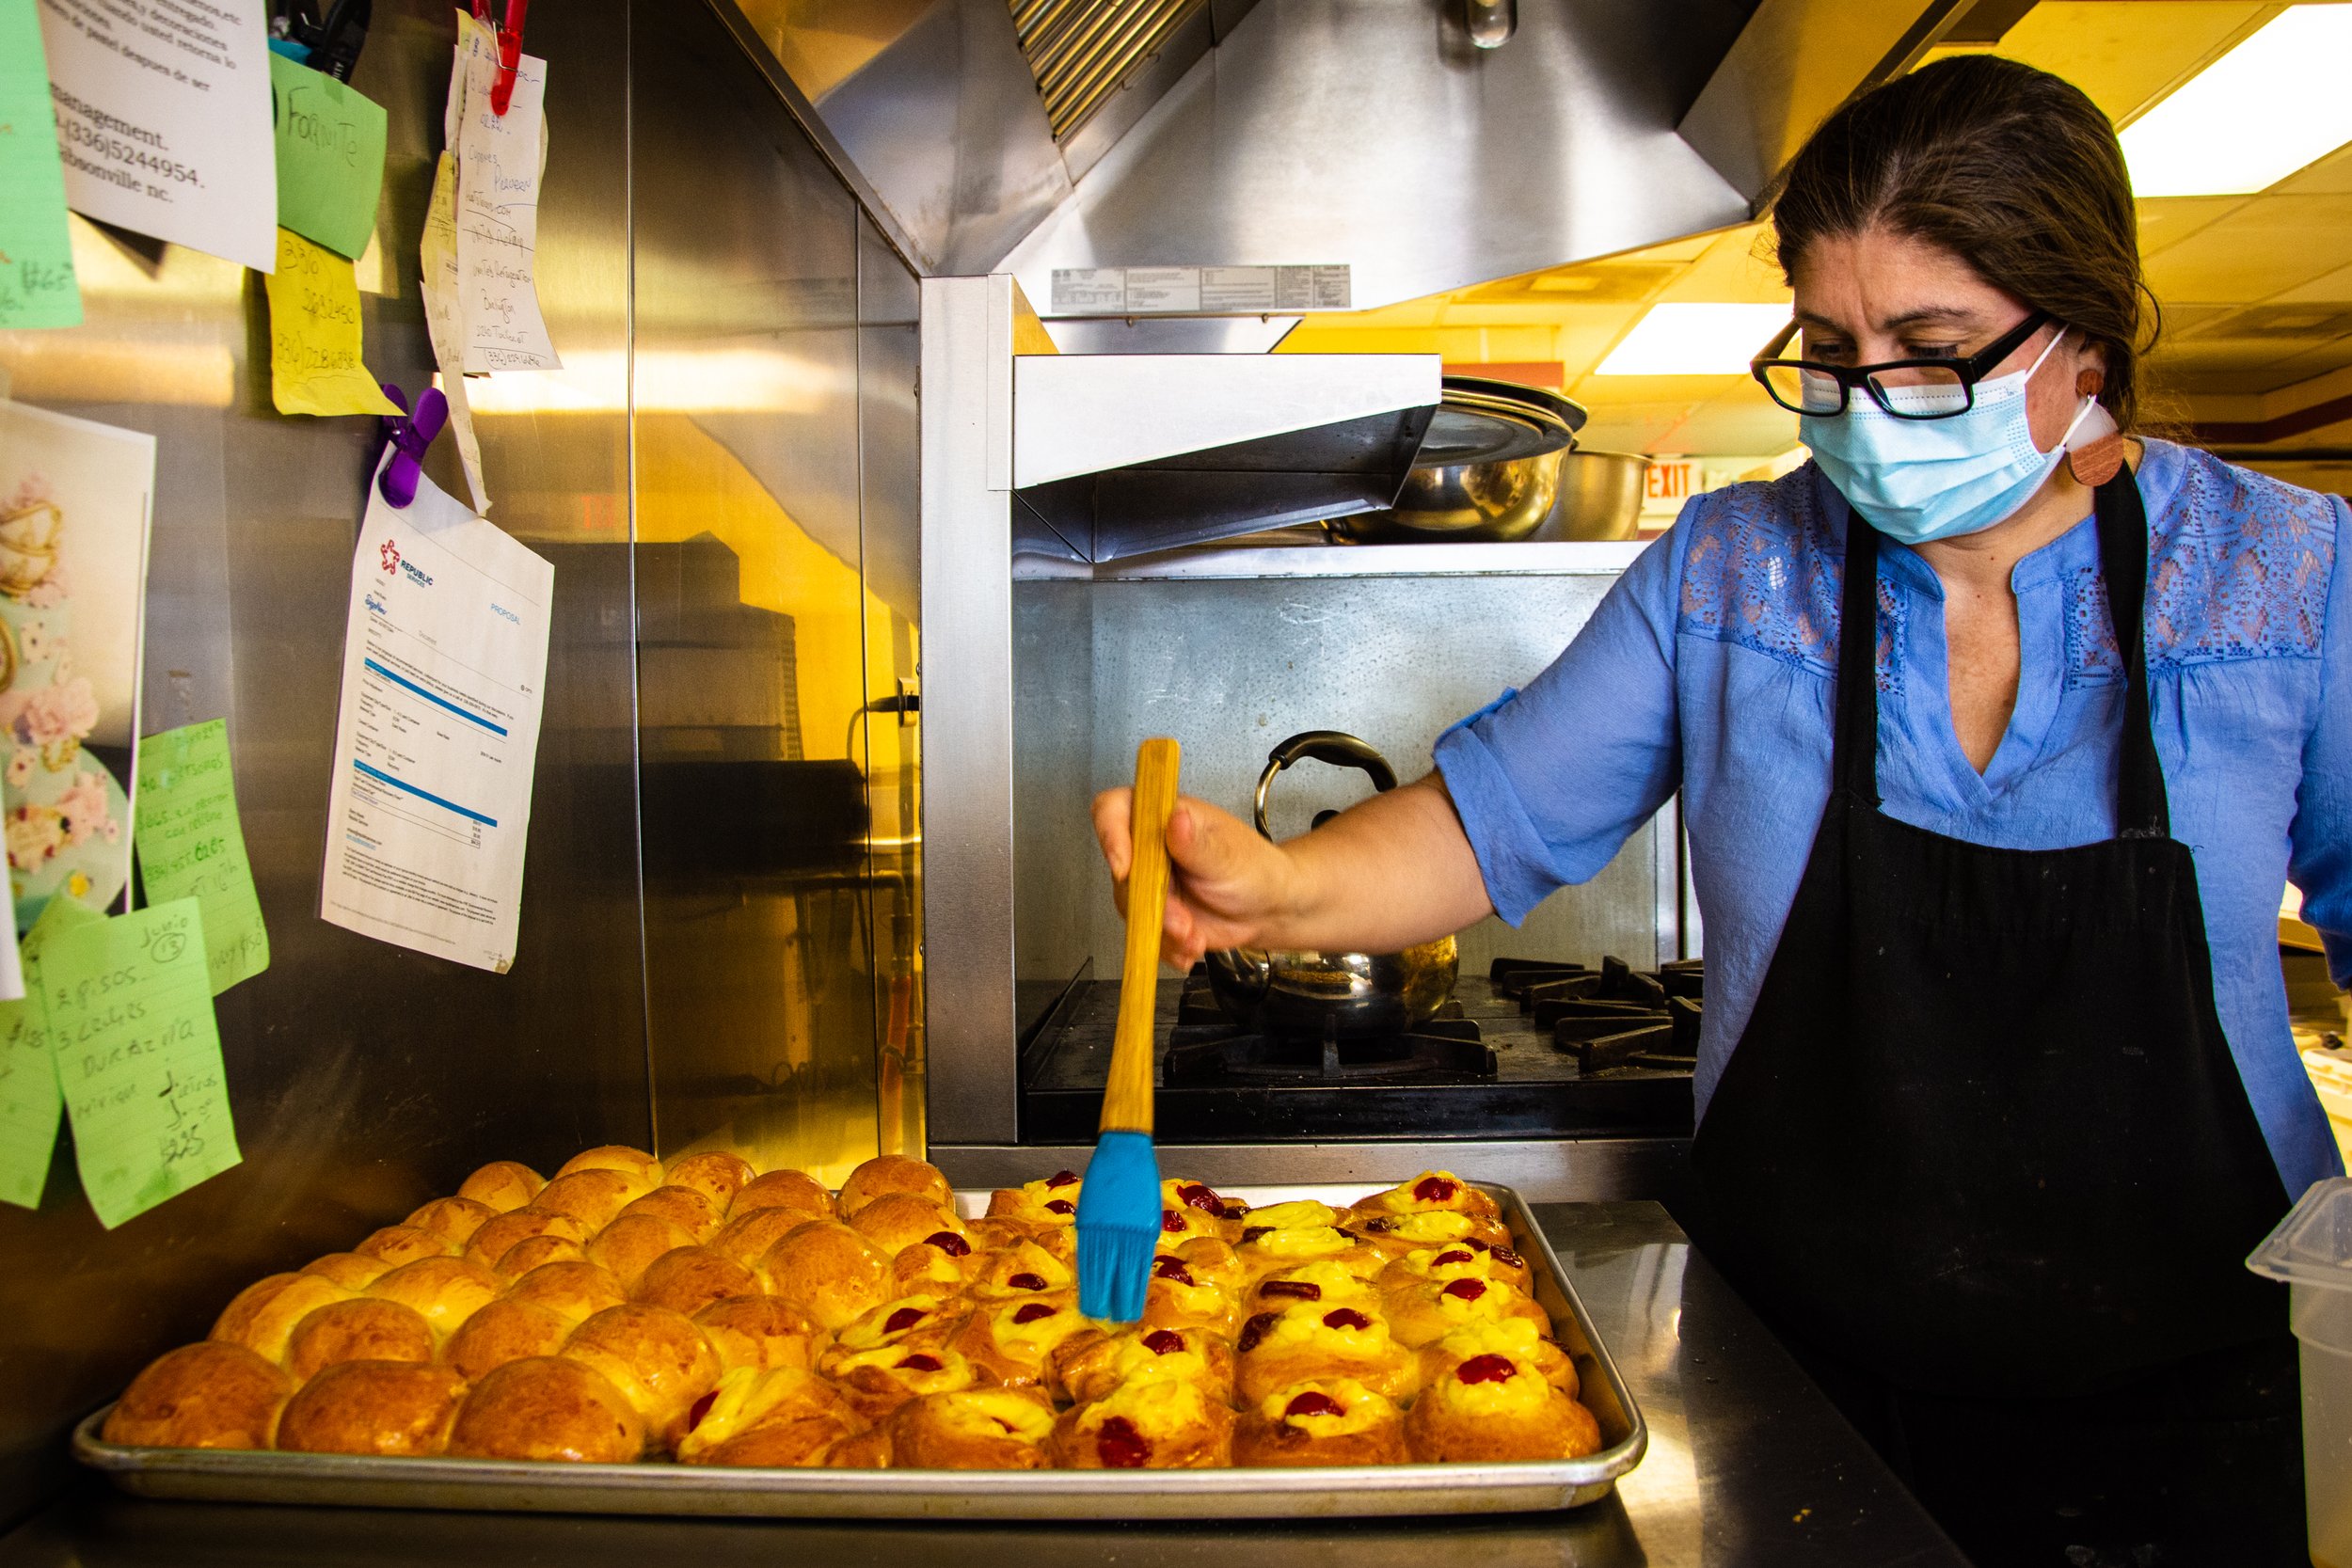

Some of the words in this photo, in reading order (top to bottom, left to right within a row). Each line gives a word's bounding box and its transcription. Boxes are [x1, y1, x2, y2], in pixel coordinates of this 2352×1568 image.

[1645, 464, 1692, 498] EXIT
[401, 559, 434, 586] REPUBLIC
[490, 603, 521, 626] PROPOSAL
